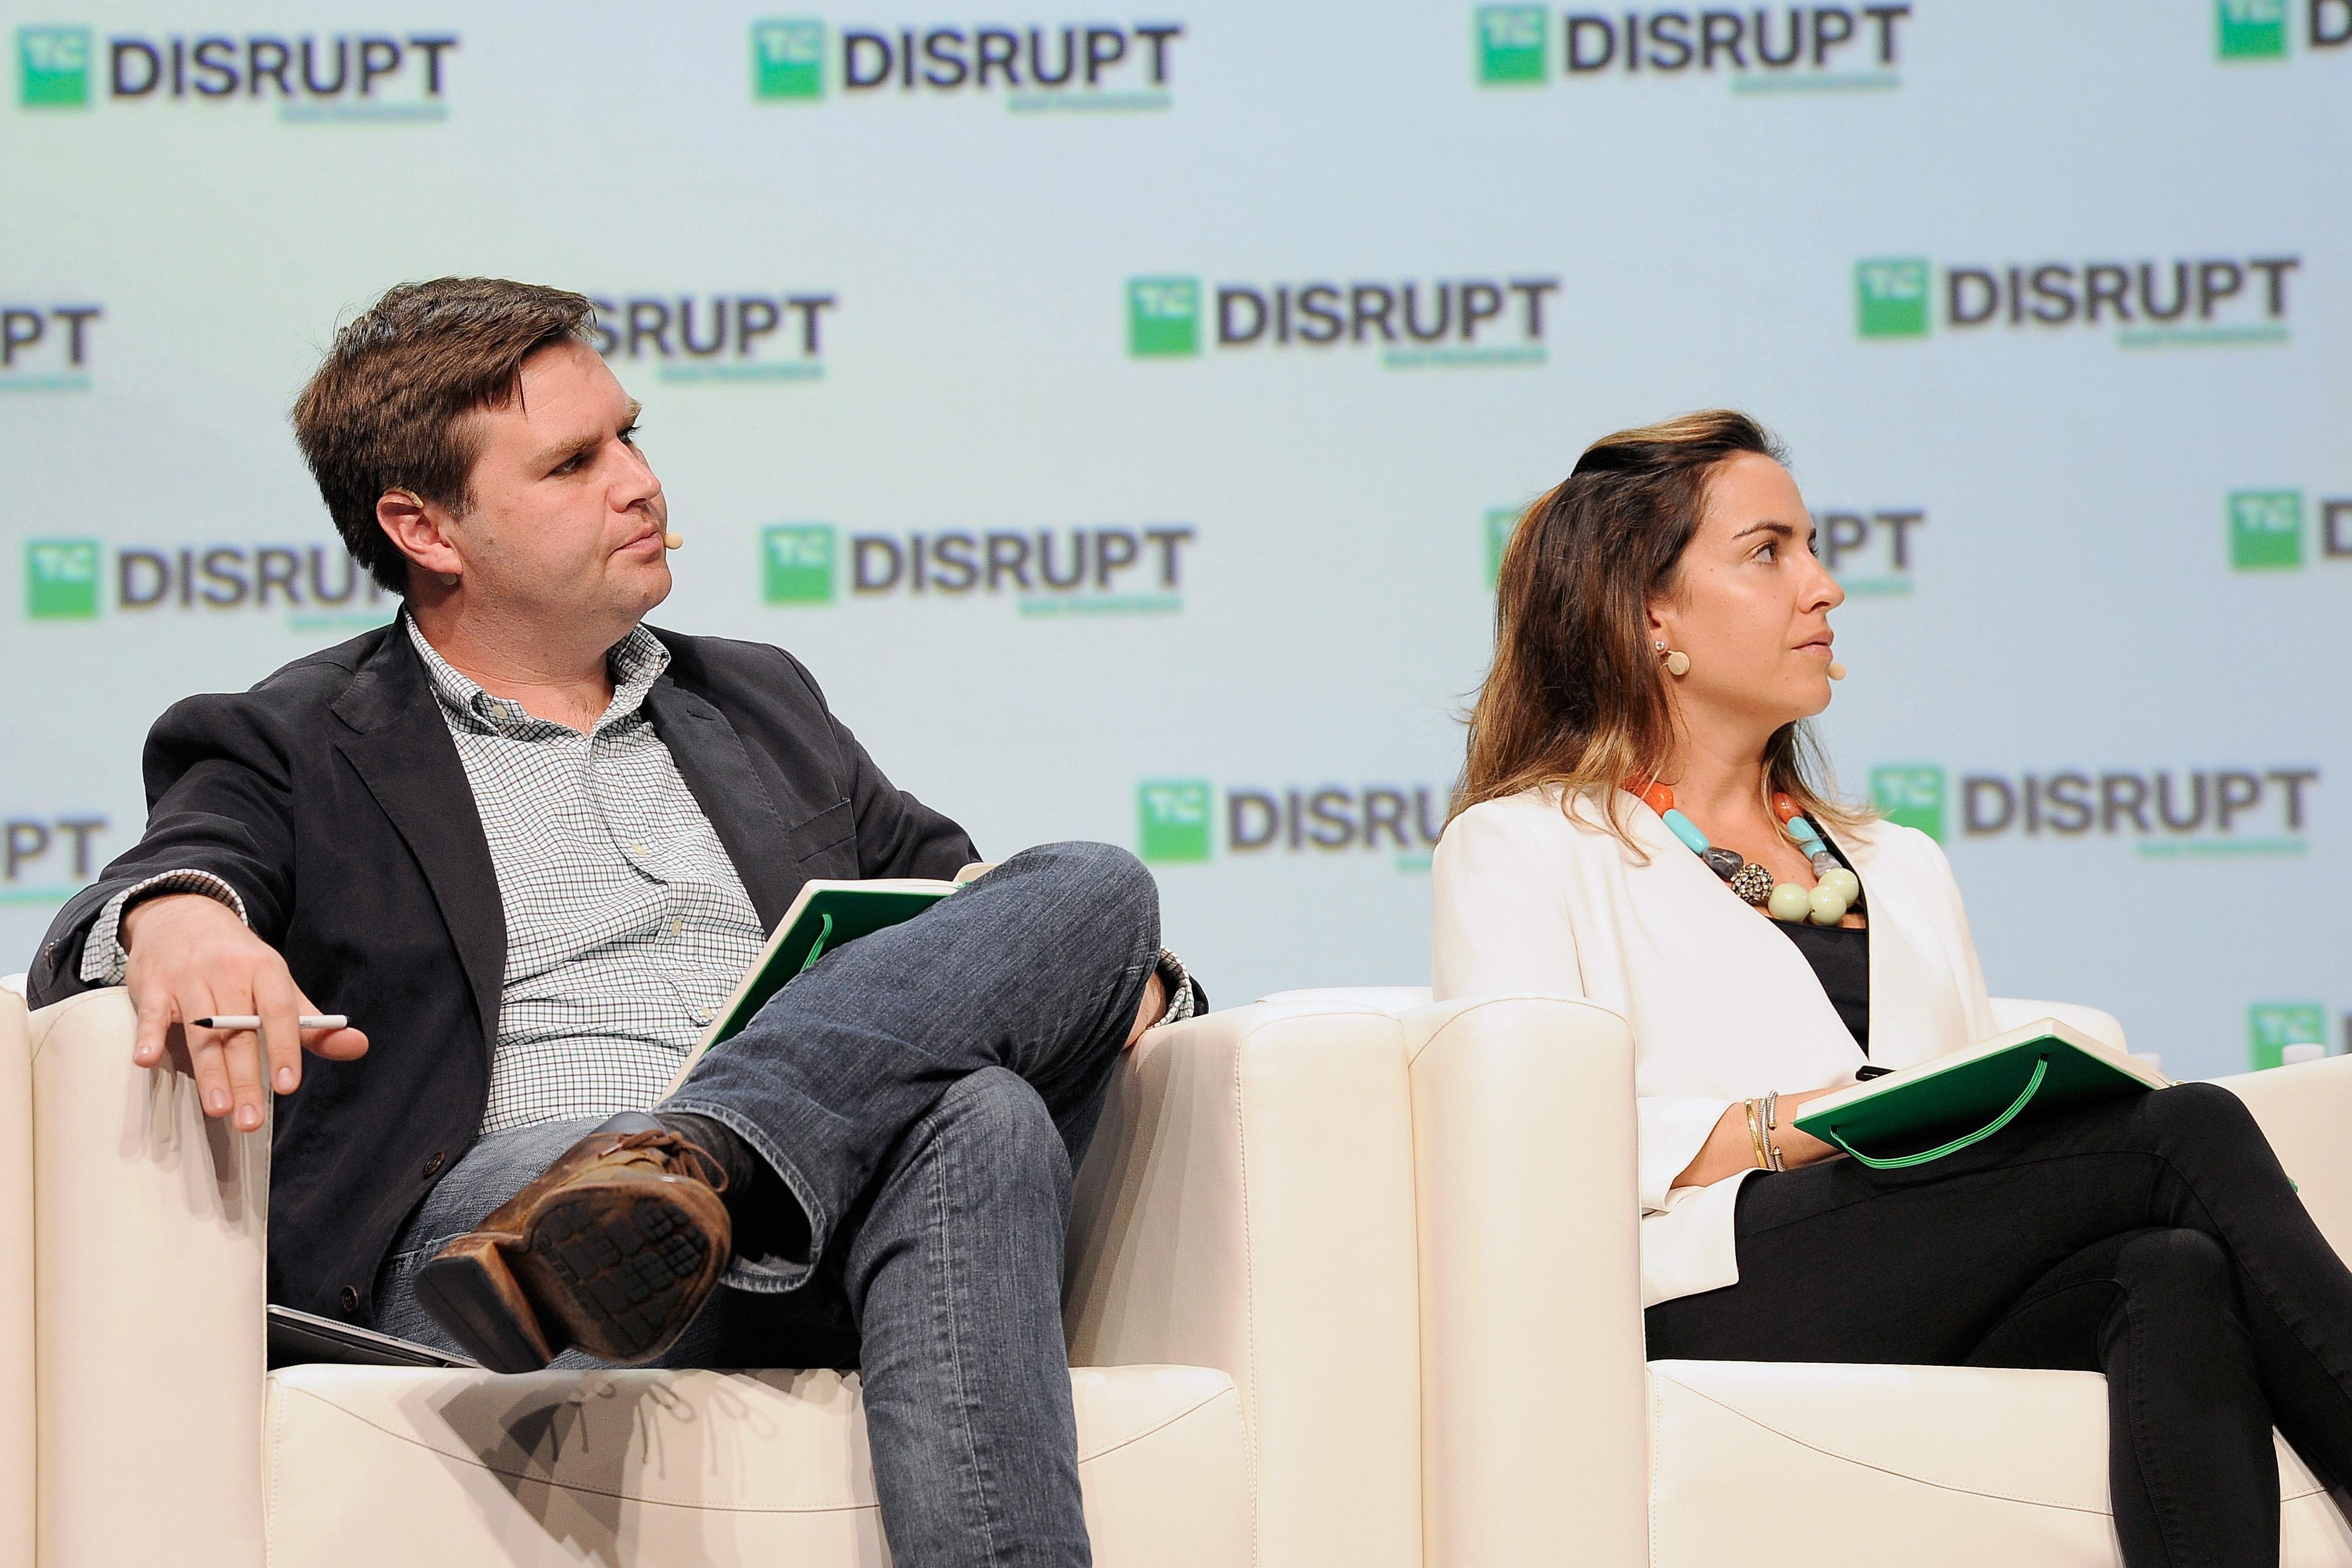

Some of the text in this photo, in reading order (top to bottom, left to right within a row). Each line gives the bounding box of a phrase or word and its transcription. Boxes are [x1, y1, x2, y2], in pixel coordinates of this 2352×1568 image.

[109, 38, 456, 100] DISRUPT
[842, 27, 1182, 92] DISRUPT
[1564, 5, 1911, 74] DISRUPT
[1216, 280, 1559, 347] DISRUPT
[1945, 258, 2300, 329] DISRUPT
[117, 547, 380, 608] DISRU
[851, 529, 1194, 595] DISRUPT
[1960, 770, 2319, 838] DISRUPT
